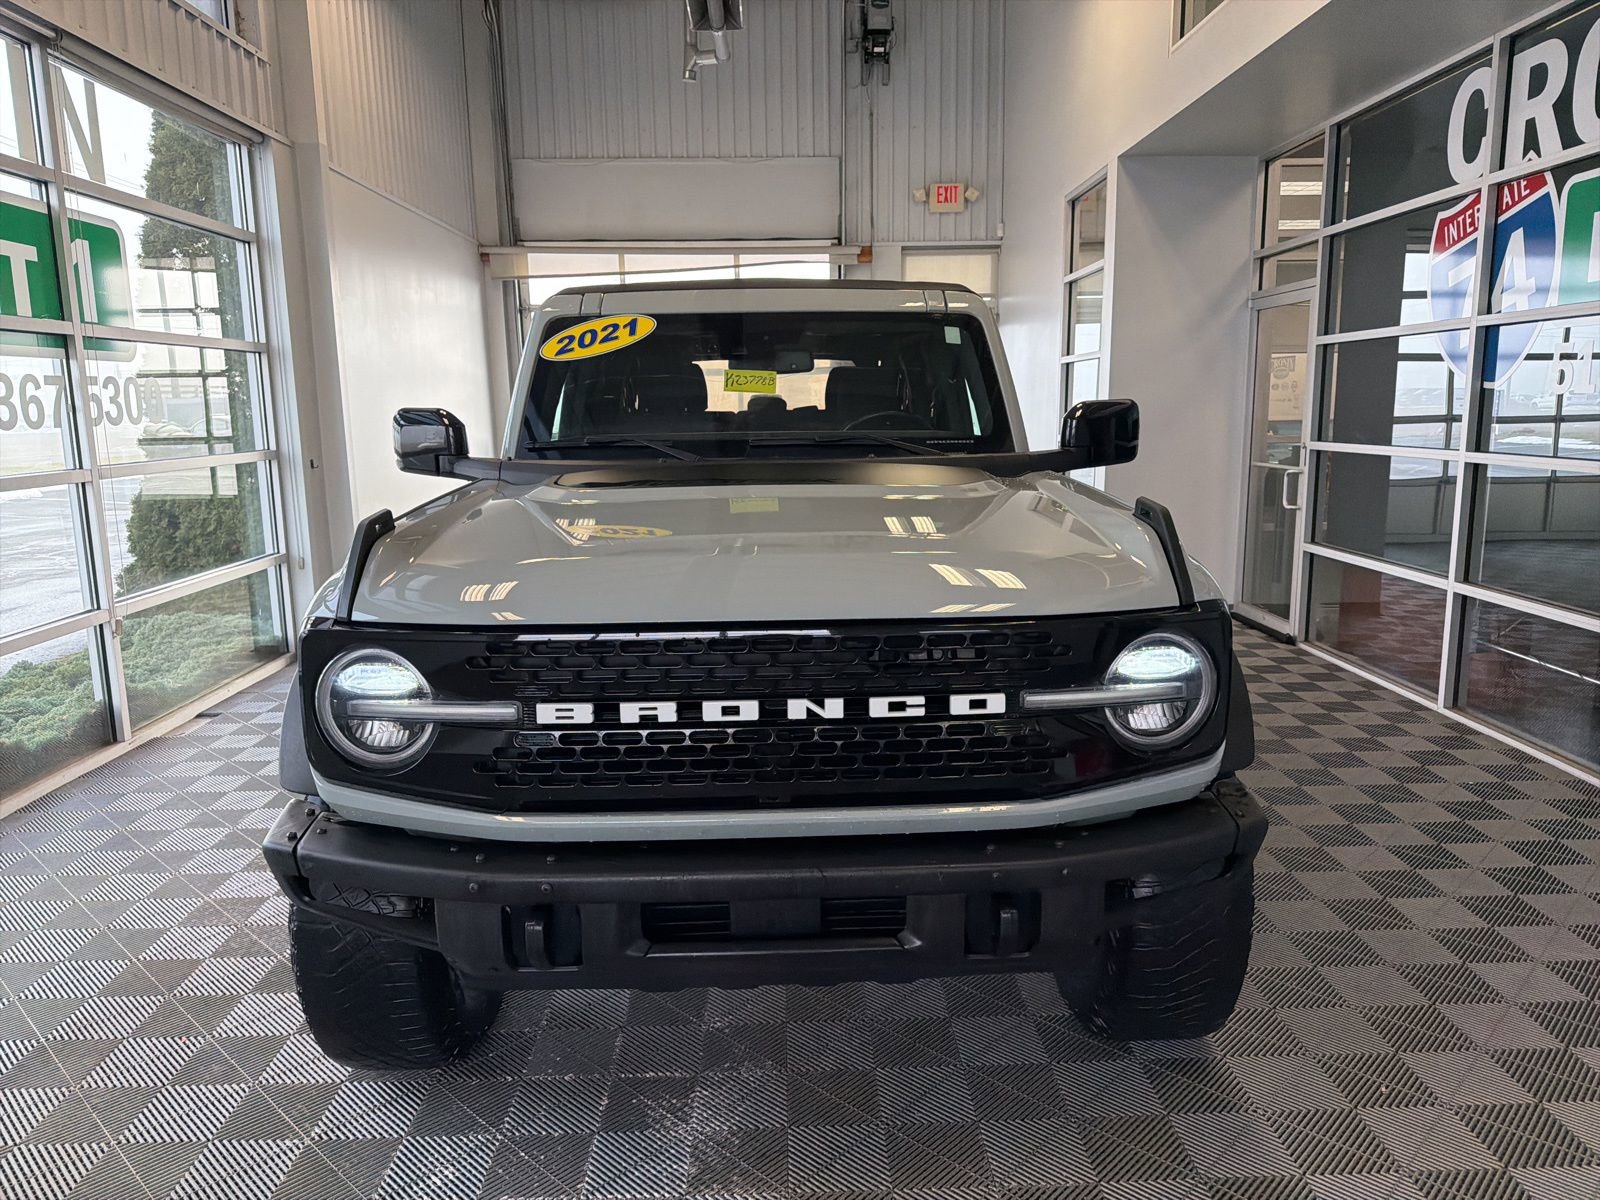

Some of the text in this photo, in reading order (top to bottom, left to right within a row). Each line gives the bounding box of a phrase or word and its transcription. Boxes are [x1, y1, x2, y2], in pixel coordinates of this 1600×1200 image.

[936, 185, 959, 203] EXIT
[1444, 177, 1531, 248] INTERATE
[1447, 226, 1537, 350] 74
[553, 317, 639, 357] 2021
[535, 692, 1006, 725] BRONCO
